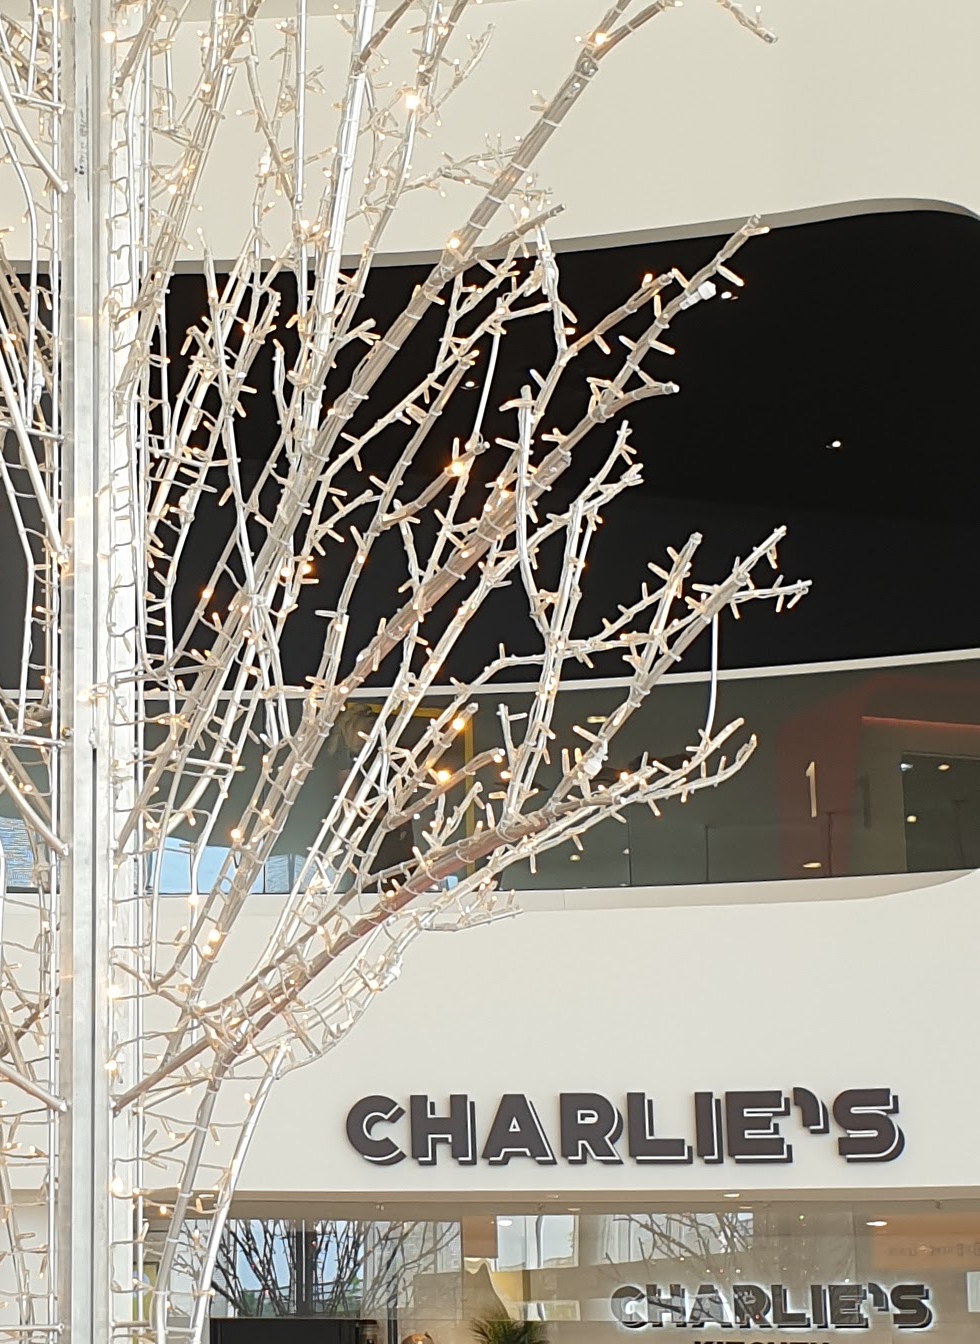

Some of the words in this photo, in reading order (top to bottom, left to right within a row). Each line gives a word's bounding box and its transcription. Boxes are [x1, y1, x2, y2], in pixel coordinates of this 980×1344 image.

[805, 761, 817, 818] 1
[346, 1087, 906, 1166] CHARLIE'S
[611, 1283, 933, 1329] CHARLIE'S
